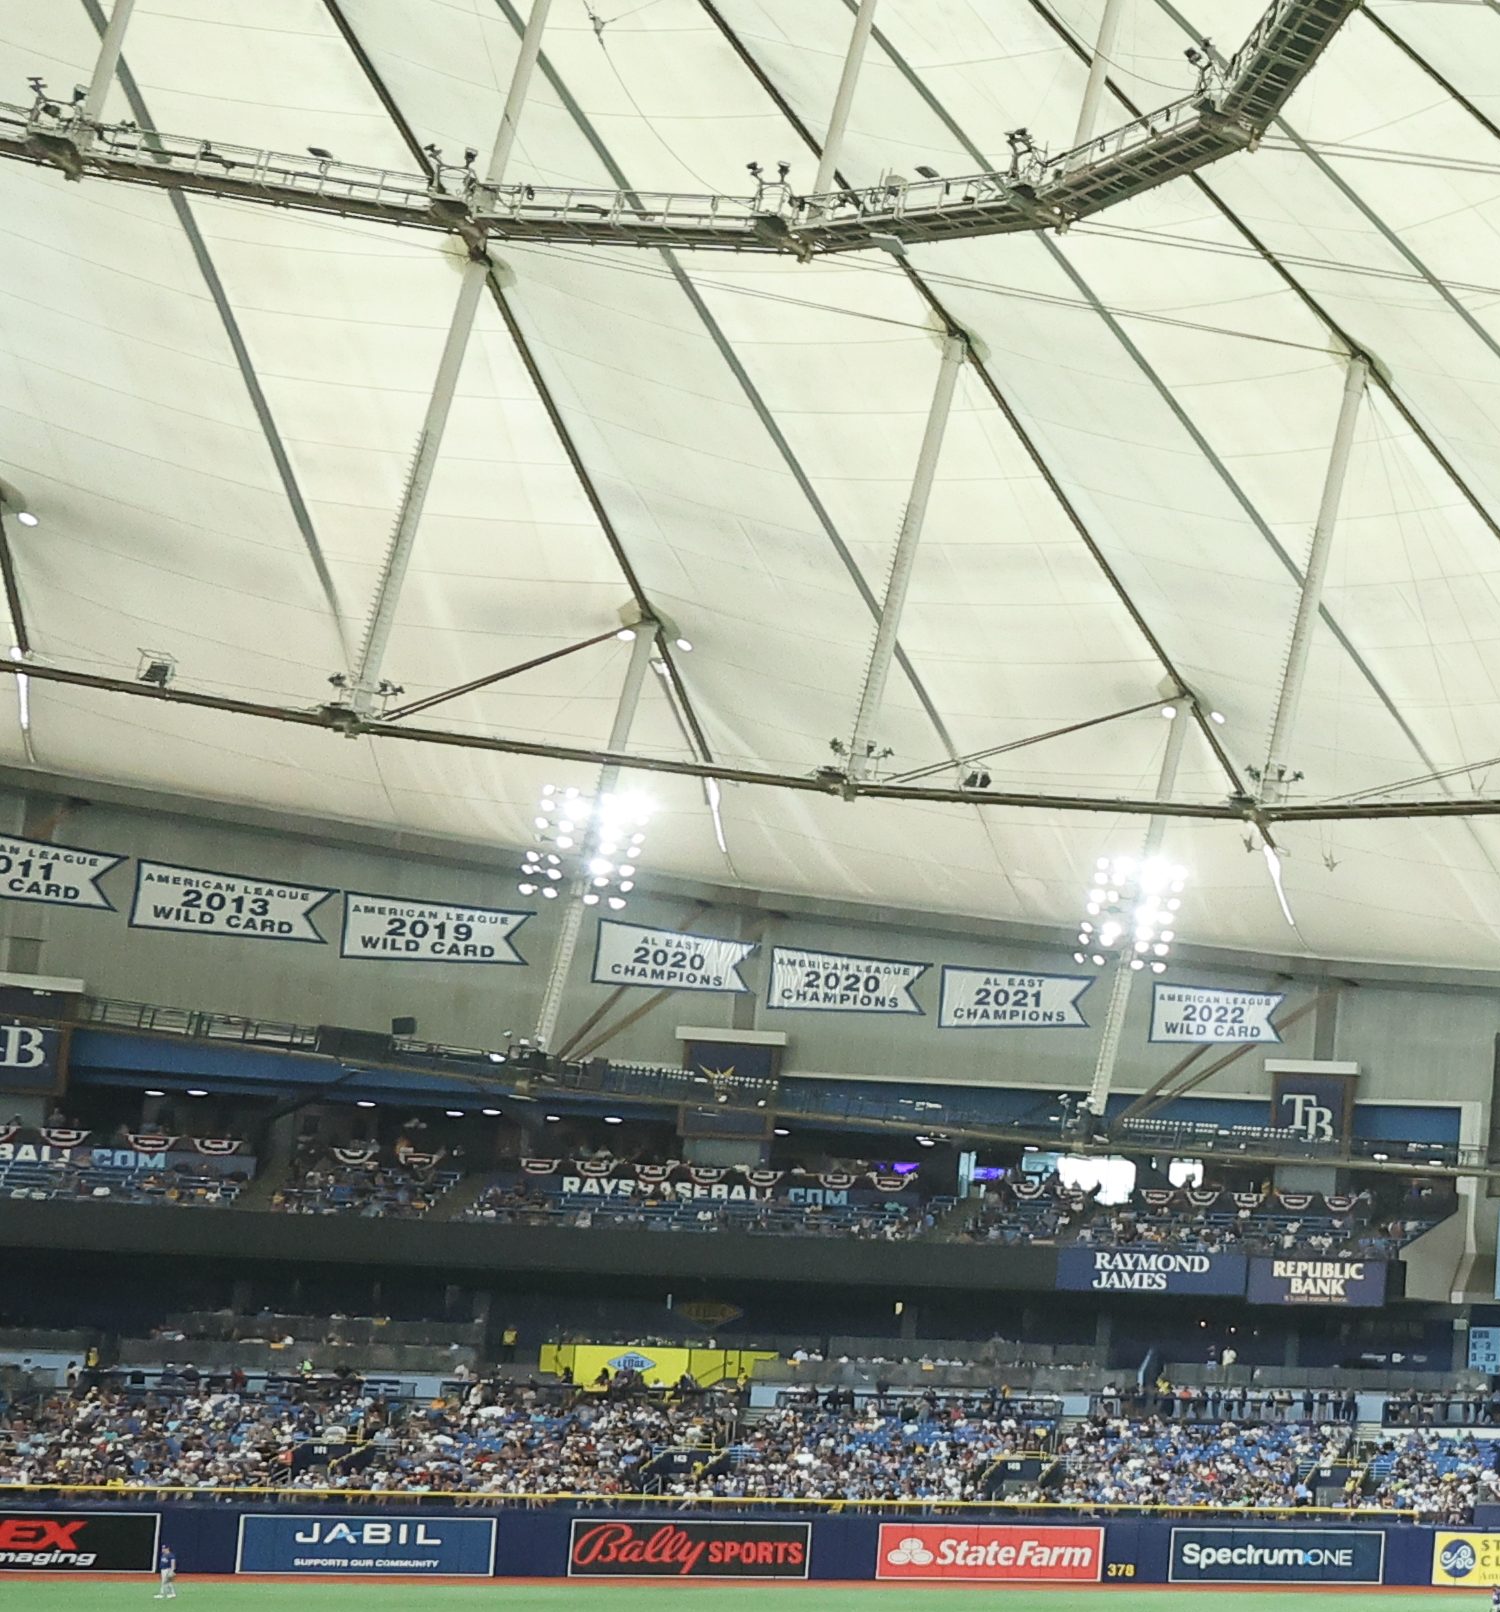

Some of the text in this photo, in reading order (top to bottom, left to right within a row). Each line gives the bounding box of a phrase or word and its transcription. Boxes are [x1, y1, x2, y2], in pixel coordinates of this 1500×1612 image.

[28, 849, 99, 867] LEAGUE
[8, 878, 80, 900] CARD
[144, 872, 310, 901] AMERICAN LEAGUE
[181, 889, 270, 917] 2013
[152, 904, 294, 934] WILD CARD
[352, 904, 509, 926] AMERICAN LEAGUE
[385, 918, 473, 942] 2019
[361, 935, 495, 958] WILD CARD
[641, 936, 702, 951] AL EAST
[632, 947, 705, 971] 2020
[777, 957, 910, 976] AMERICAN LEAGUE
[611, 963, 723, 987] CHAMPIONS
[803, 970, 881, 993] 2020
[983, 977, 1044, 988] AL EAST
[781, 988, 899, 1009] CHAMPIONS
[974, 988, 1043, 1009] 2021
[1159, 992, 1273, 1007] AMERICAN LEAGUE
[953, 1008, 1066, 1023] CHAMPIONS
[1182, 1004, 1245, 1025] 2022
[1164, 1021, 1261, 1039] WILD CARD
[1094, 1251, 1210, 1274] RAYMOND
[1273, 1260, 1365, 1281] REPUBLIC
[1092, 1271, 1167, 1291] JAMES
[1290, 1278, 1345, 1297] BANK
[295, 1522, 442, 1545] JABIL
[571, 1523, 803, 1575] Bally SPORTS
[294, 1558, 440, 1568] SUPPORTS OUR COMMUNITY
